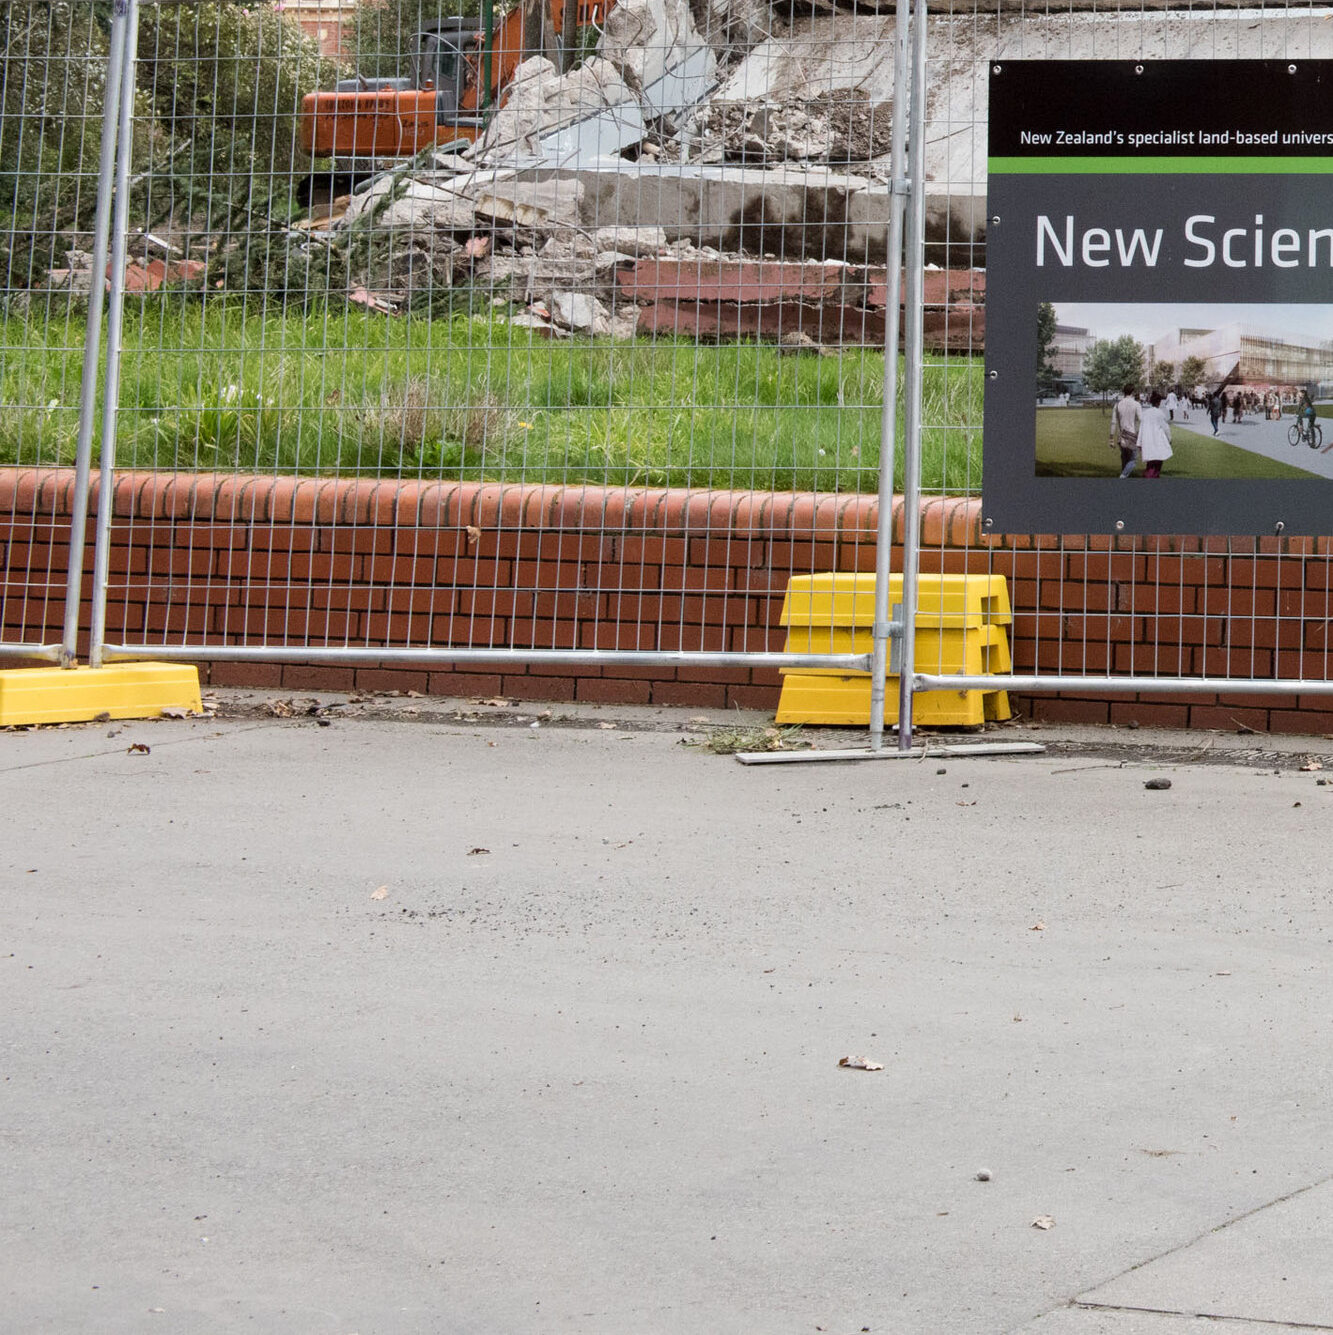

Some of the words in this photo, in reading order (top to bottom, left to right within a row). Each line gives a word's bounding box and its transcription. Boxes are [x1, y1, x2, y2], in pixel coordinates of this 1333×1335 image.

[1021, 131, 1052, 144] New
[1056, 131, 1123, 144] Zealand’s
[1128, 131, 1194, 147] specialist
[1199, 130, 1277, 144] land-based
[1037, 216, 1163, 267] New
